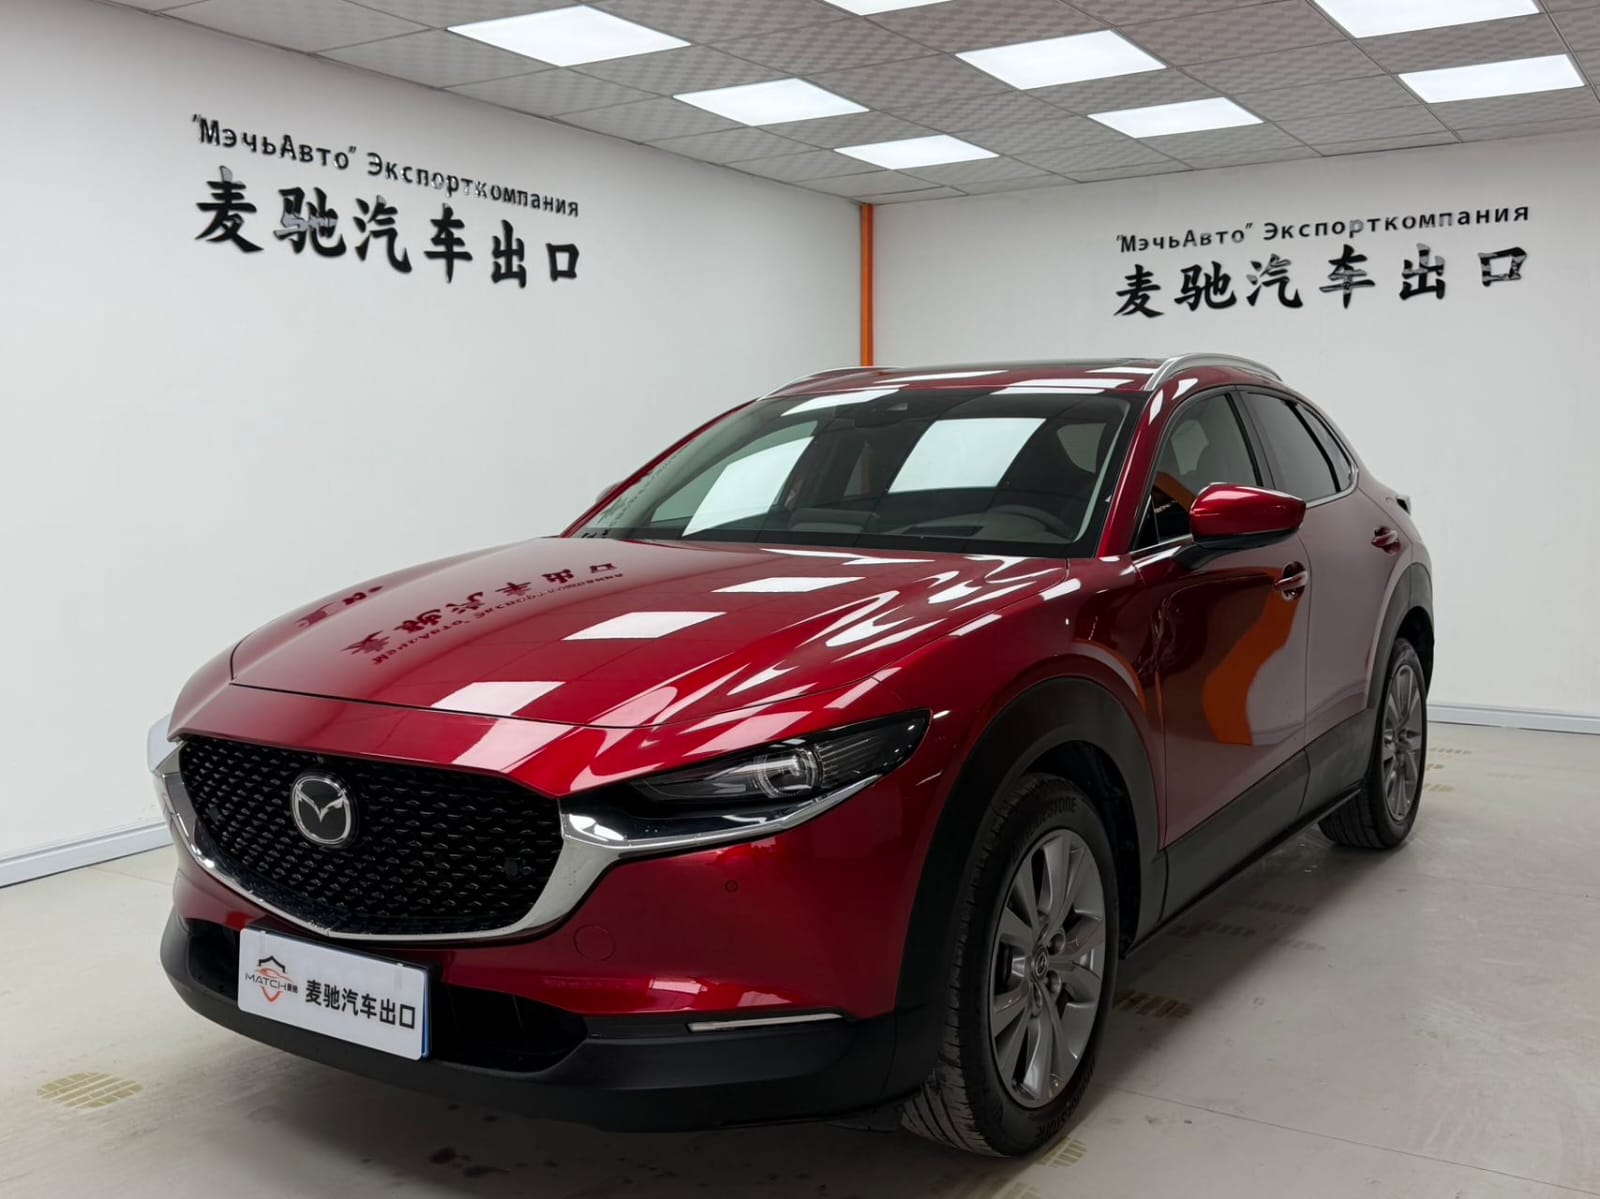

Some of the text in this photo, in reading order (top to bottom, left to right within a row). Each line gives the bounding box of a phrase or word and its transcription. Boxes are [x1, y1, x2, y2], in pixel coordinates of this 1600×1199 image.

[367, 152, 580, 218] Экспорткомпания
[195, 166, 580, 290] 麦驰汽车出口
[1264, 205, 1530, 240] Экспорткомпания
[1113, 243, 1528, 319] 麦驰汽车出口
[245, 972, 287, 991] MATCH
[305, 979, 416, 1030] 麦驰汽车出口
